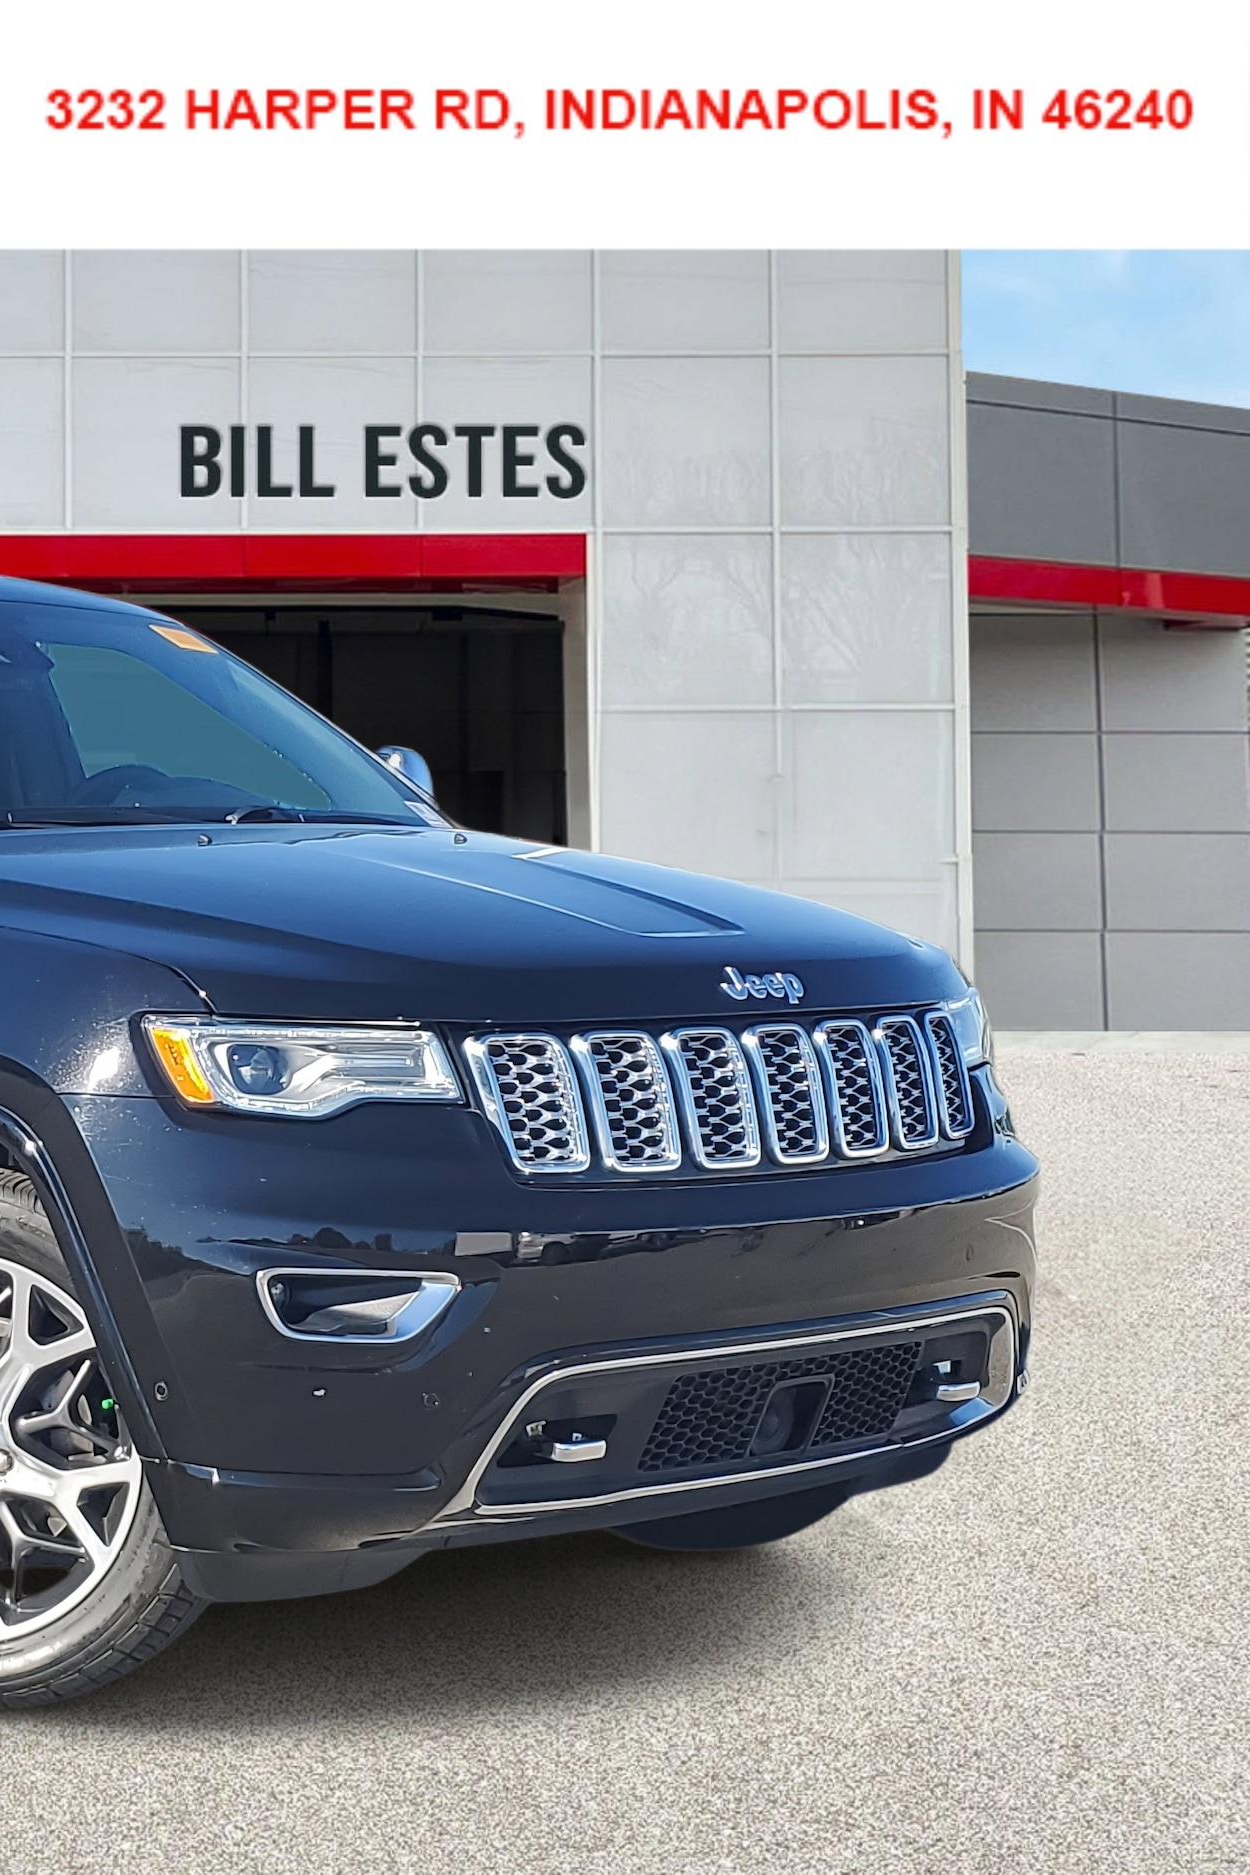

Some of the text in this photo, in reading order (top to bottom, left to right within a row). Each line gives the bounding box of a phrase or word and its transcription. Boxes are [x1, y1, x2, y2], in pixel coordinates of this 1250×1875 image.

[179, 423, 586, 500] BILL ESTES
[720, 966, 804, 1004] Jeep
